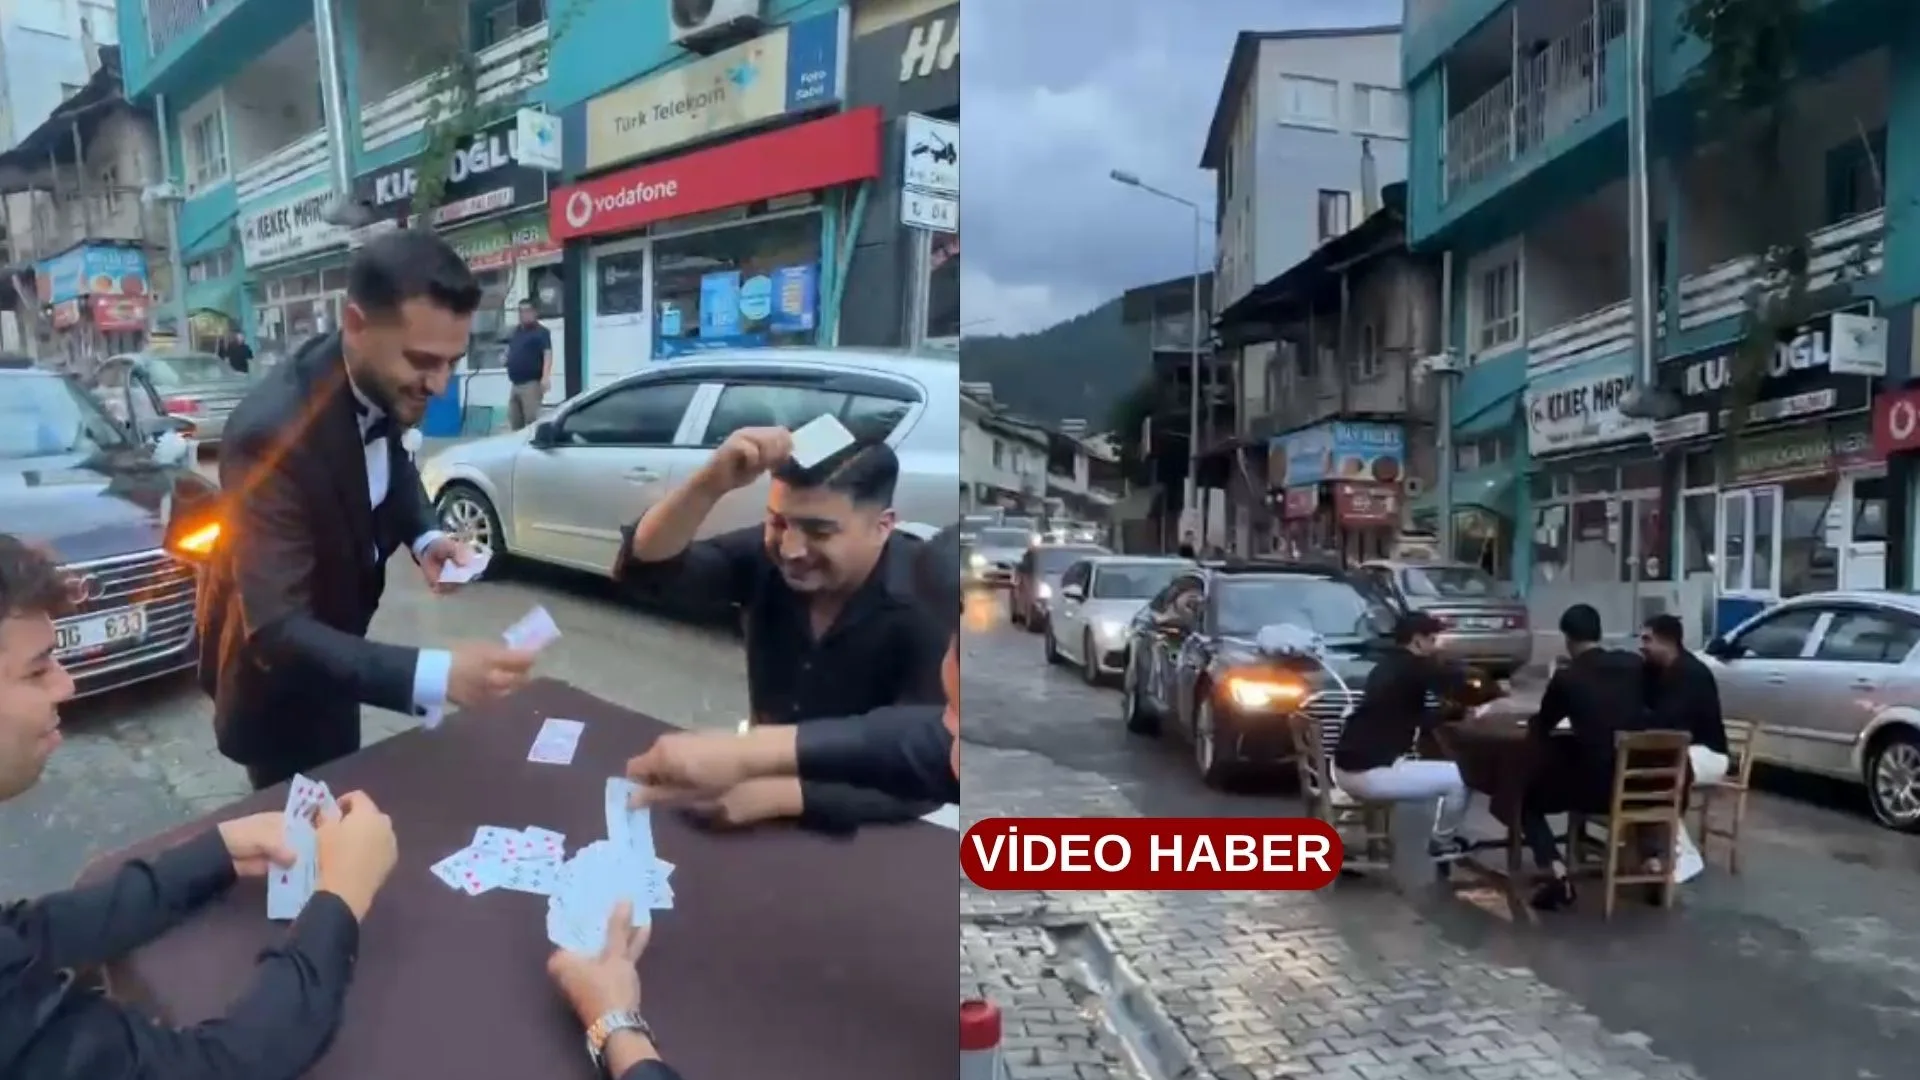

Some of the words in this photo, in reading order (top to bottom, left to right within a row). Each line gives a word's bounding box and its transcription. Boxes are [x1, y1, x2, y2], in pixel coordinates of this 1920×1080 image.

[614, 109, 647, 136] Türk
[652, 86, 725, 121] Telekom
[594, 180, 678, 212] vodafone
